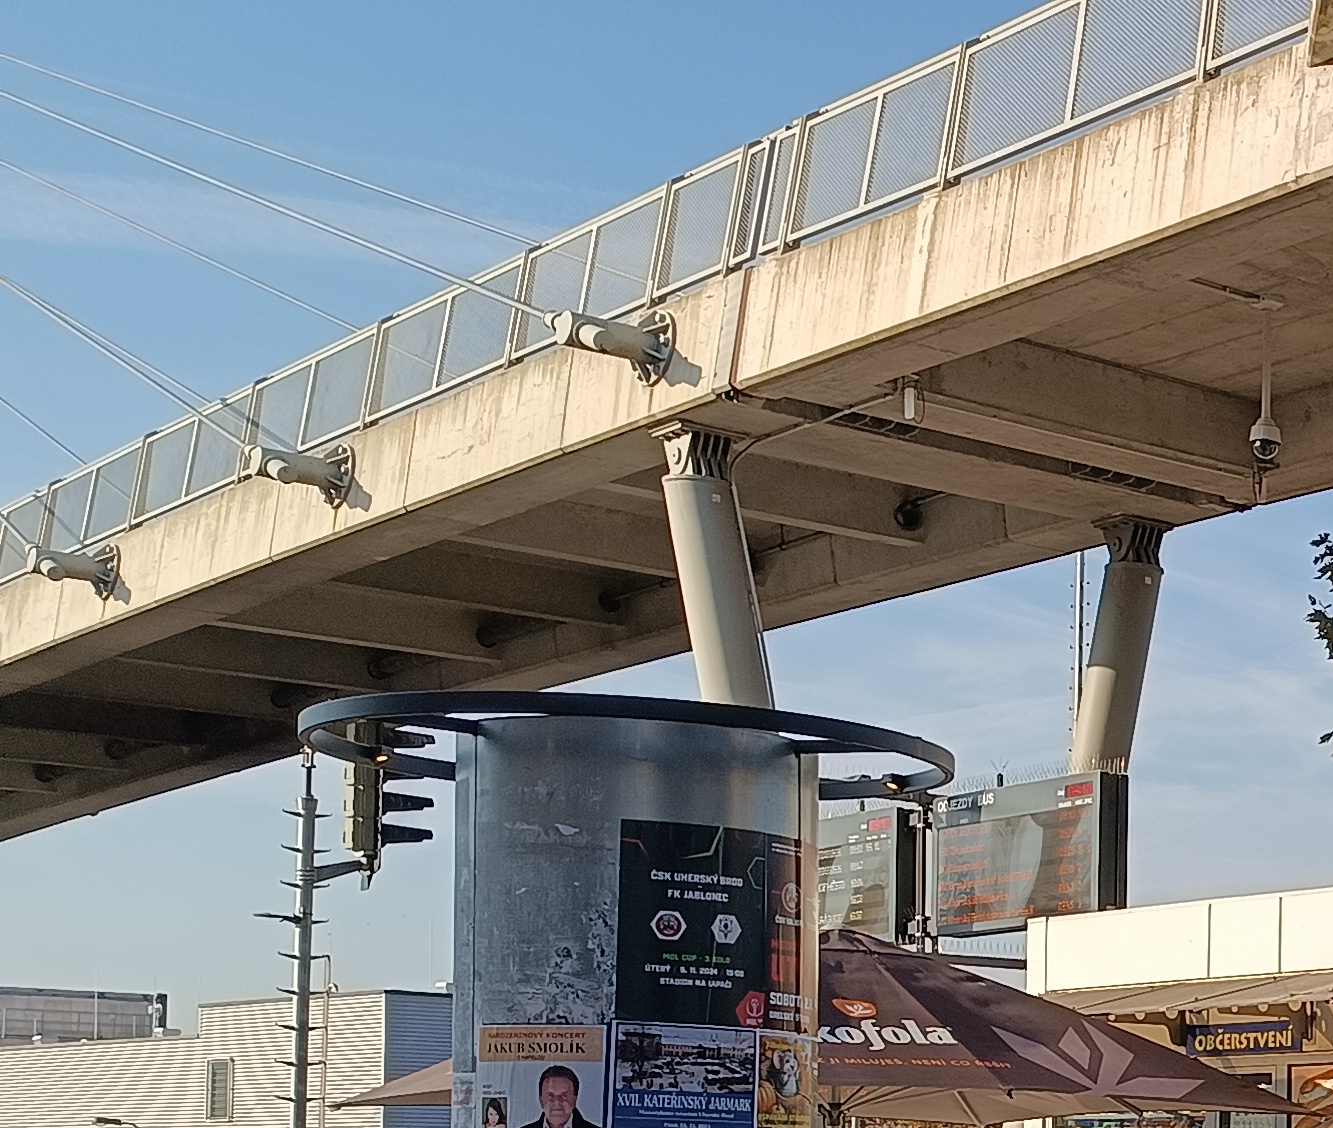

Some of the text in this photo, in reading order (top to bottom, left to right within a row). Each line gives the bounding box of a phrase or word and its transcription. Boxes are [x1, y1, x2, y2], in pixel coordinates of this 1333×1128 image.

[978, 792, 994, 806] BUS
[651, 869, 671, 881] ČSK
[668, 889, 680, 899] FK
[1194, 1024, 1293, 1052] OBČERSTVENÍ
[487, 1040, 586, 1054] JAKUB SMOLÍK
[644, 1093, 708, 1110] KATEŘINSKÝ
[708, 1096, 752, 1112] JARMARK
